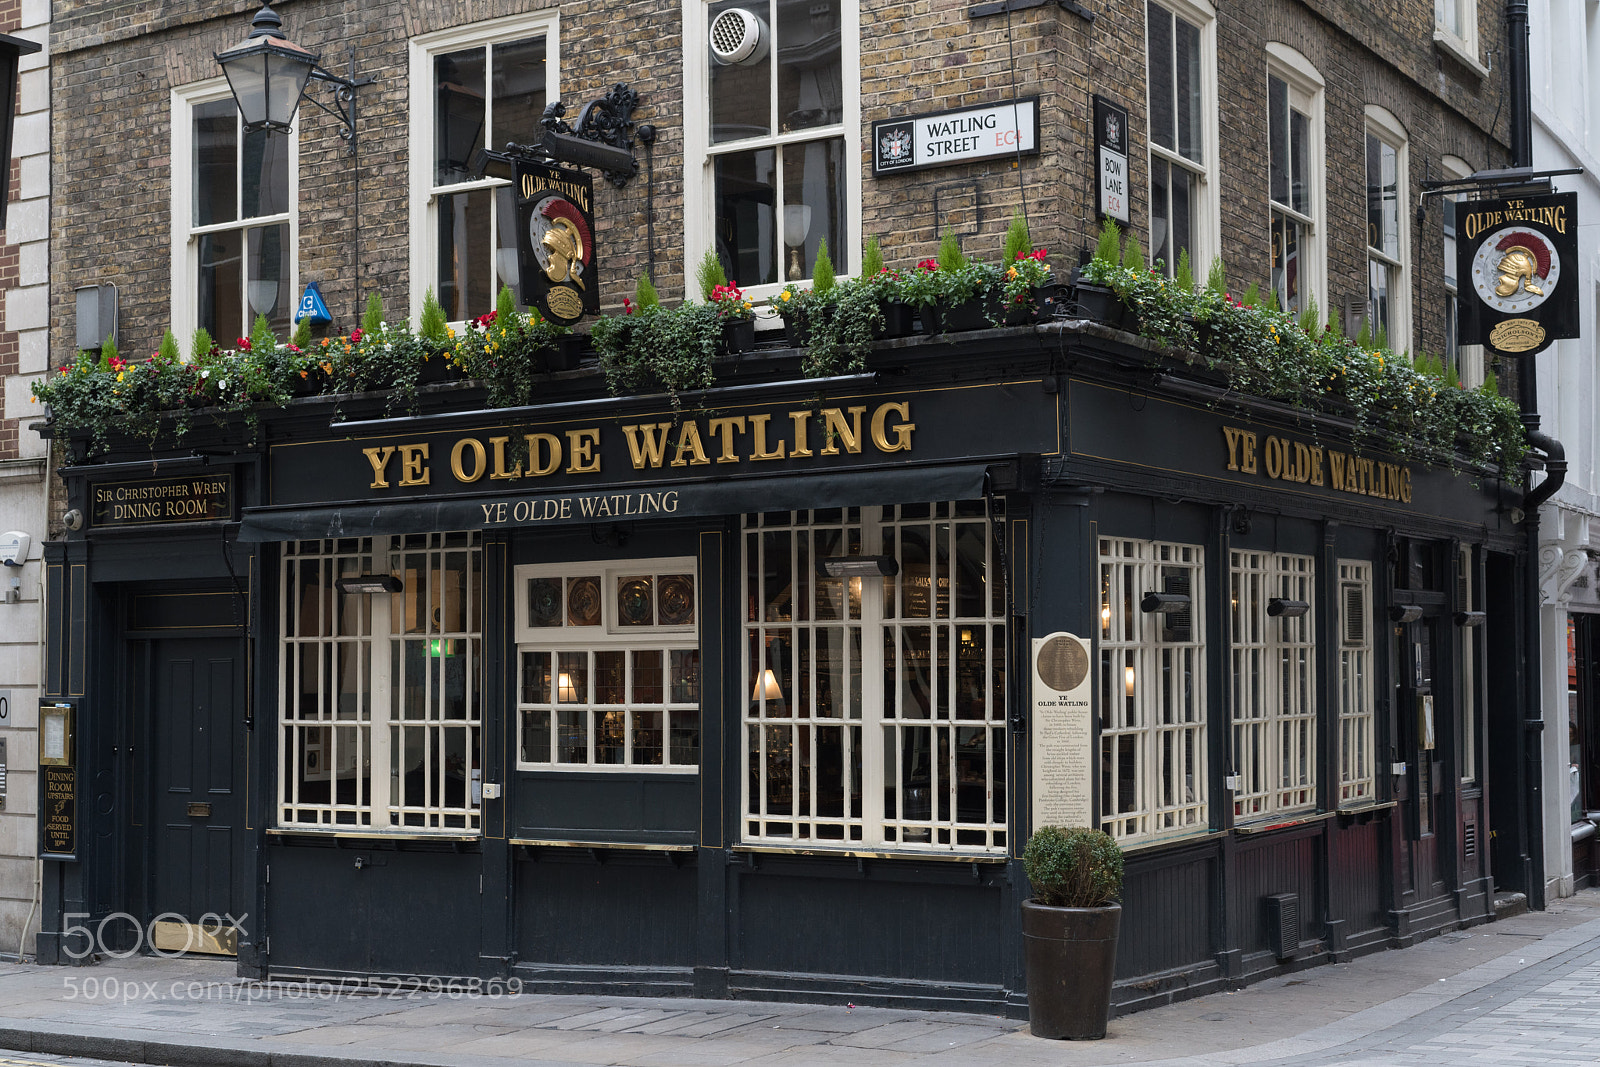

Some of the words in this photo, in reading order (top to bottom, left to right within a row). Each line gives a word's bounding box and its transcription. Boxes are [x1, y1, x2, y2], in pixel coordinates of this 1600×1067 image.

[927, 114, 996, 138] WATLING
[927, 136, 980, 157] STREET
[995, 129, 1023, 147] EC4
[549, 169, 561, 180] YE
[1105, 157, 1121, 176] BOW
[522, 173, 547, 199] OLDE
[547, 179, 589, 213] WATLING
[1105, 175, 1122, 195] LANE
[1108, 195, 1120, 212] EC4
[1507, 199, 1525, 209] YE
[1465, 211, 1503, 240] OLDE
[1504, 205, 1567, 235] WATLING
[299, 309, 317, 318] Chubb
[363, 442, 430, 489] YE
[451, 428, 602, 483] OLDE
[622, 401, 916, 470] WATLING
[1223, 426, 1257, 475] YE
[1265, 435, 1323, 487] OLDE
[1328, 449, 1411, 503] WATLING
[114, 502, 161, 520] DINING
[166, 499, 208, 517] ROOM
[482, 502, 508, 524] YE
[513, 498, 572, 522] OLDE
[578, 490, 679, 518] WATLING
[48, 771, 74, 783] DINING
[48, 792, 74, 800] UPSTAIRS
[49, 782, 72, 792] ROOM
[48, 823, 72, 832] SERVED
[52, 815, 69, 823] FOOD
[51, 831, 70, 840] UNTIL
